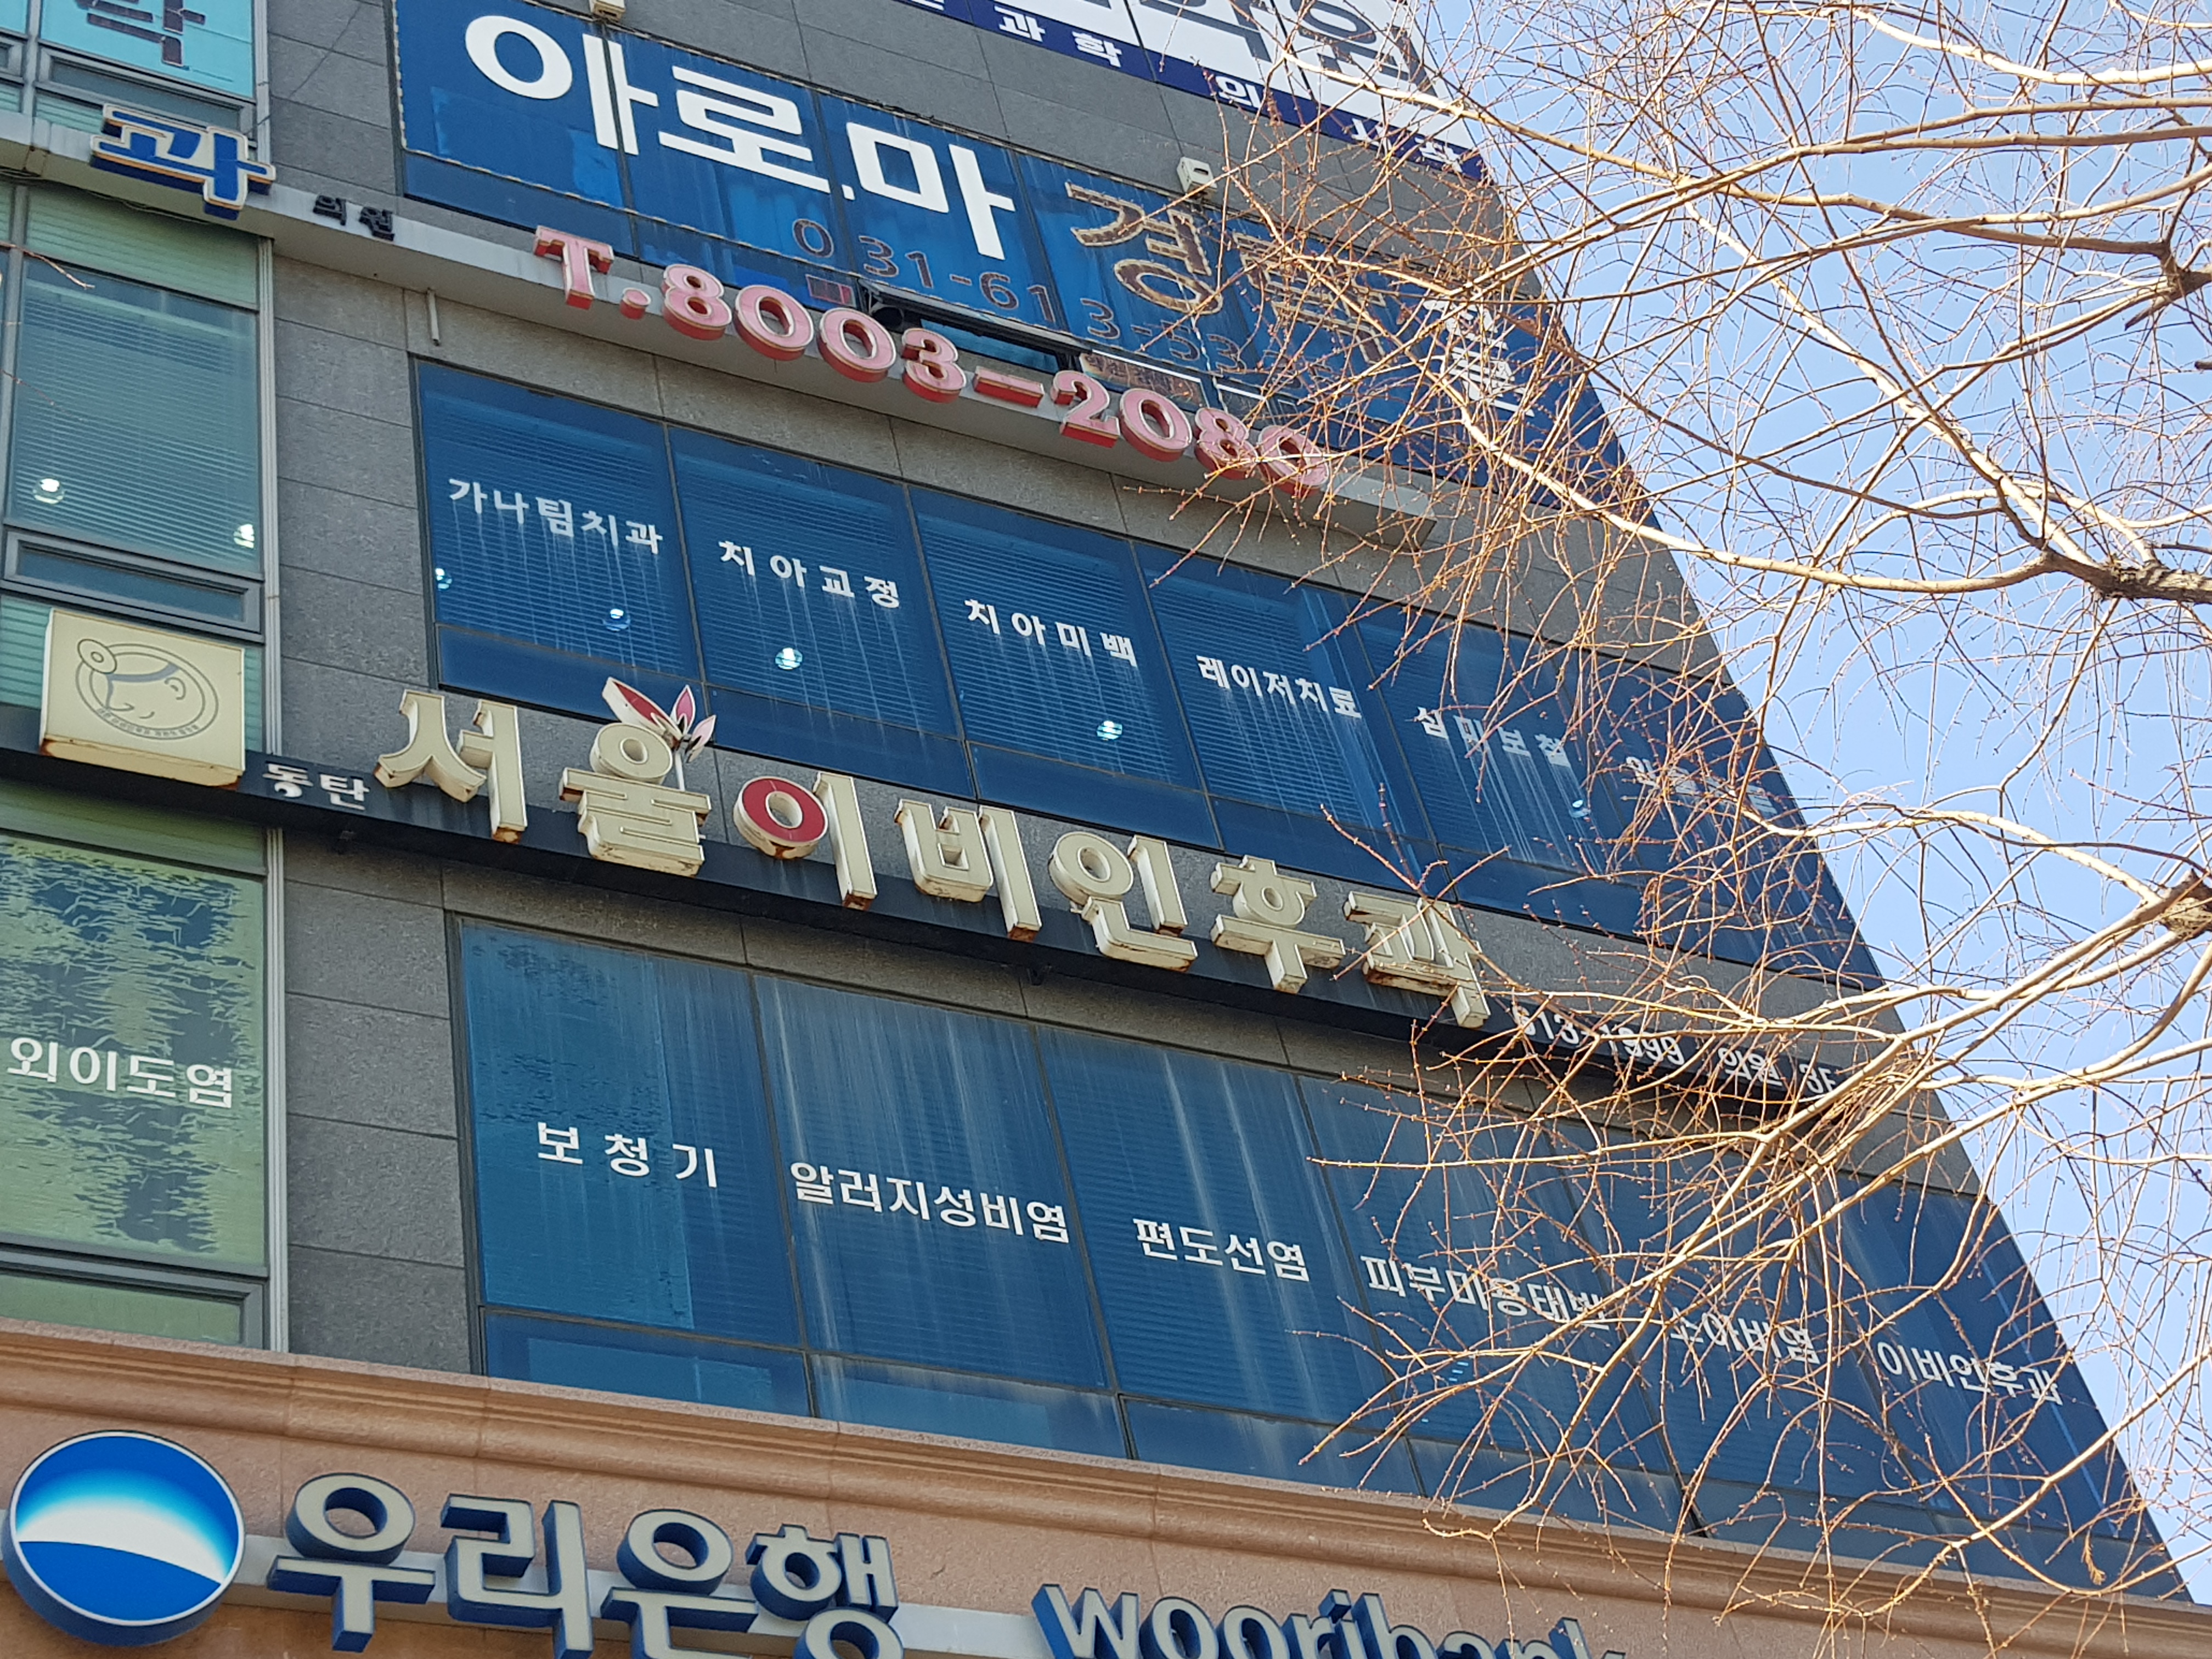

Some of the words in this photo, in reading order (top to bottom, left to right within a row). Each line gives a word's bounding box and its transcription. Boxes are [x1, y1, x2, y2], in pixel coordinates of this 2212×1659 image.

[90, 103, 276, 220] 과
[465, 15, 1015, 261] 아로마
[719, 540, 900, 608] 치아교정
[964, 599, 1138, 667] 치아미백
[1196, 654, 1362, 718] 레이저치료
[262, 762, 370, 811] 동탄
[374, 689, 1491, 1028] 서울이비인후과
[7, 1036, 232, 1108] 외이도염
[537, 1121, 718, 1188] 보청기
[790, 1162, 1069, 1244] 알러지성비염
[1132, 1218, 1310, 1282] 편도선염
[1877, 1341, 2064, 1406] 이비인후과
[267, 1472, 905, 1659] 우리은행
